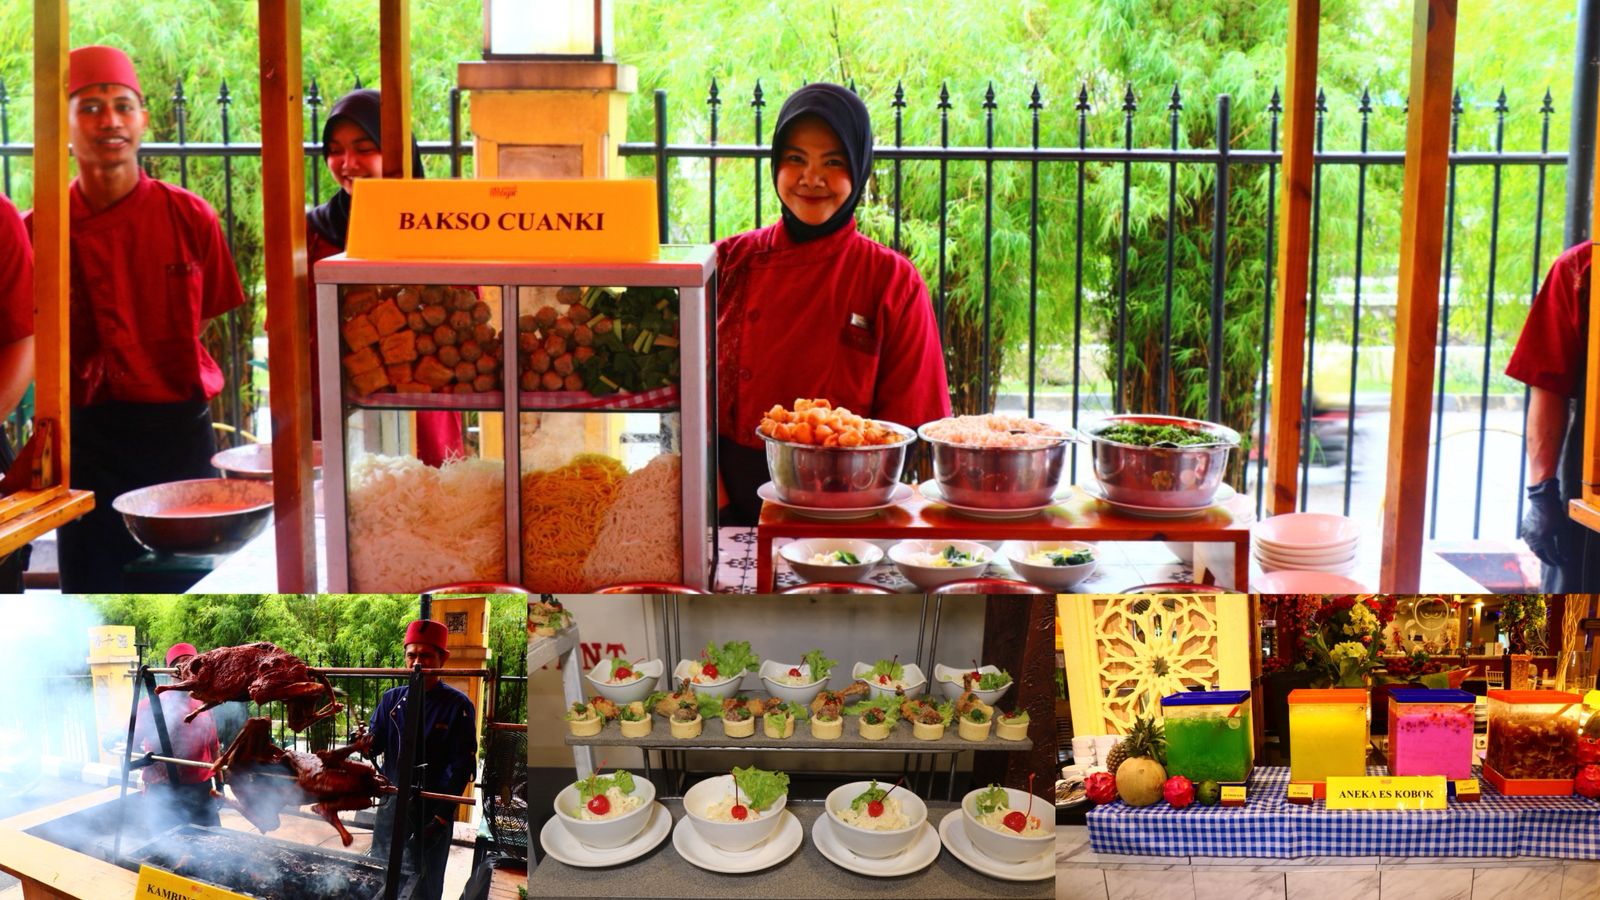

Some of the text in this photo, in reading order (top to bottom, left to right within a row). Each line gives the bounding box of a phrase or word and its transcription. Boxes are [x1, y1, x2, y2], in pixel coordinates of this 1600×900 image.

[399, 212, 605, 231] BAKSO CUANKI
[1339, 790, 1434, 799] ANEKA ES KOBOK
[147, 883, 196, 900] KAMBI
